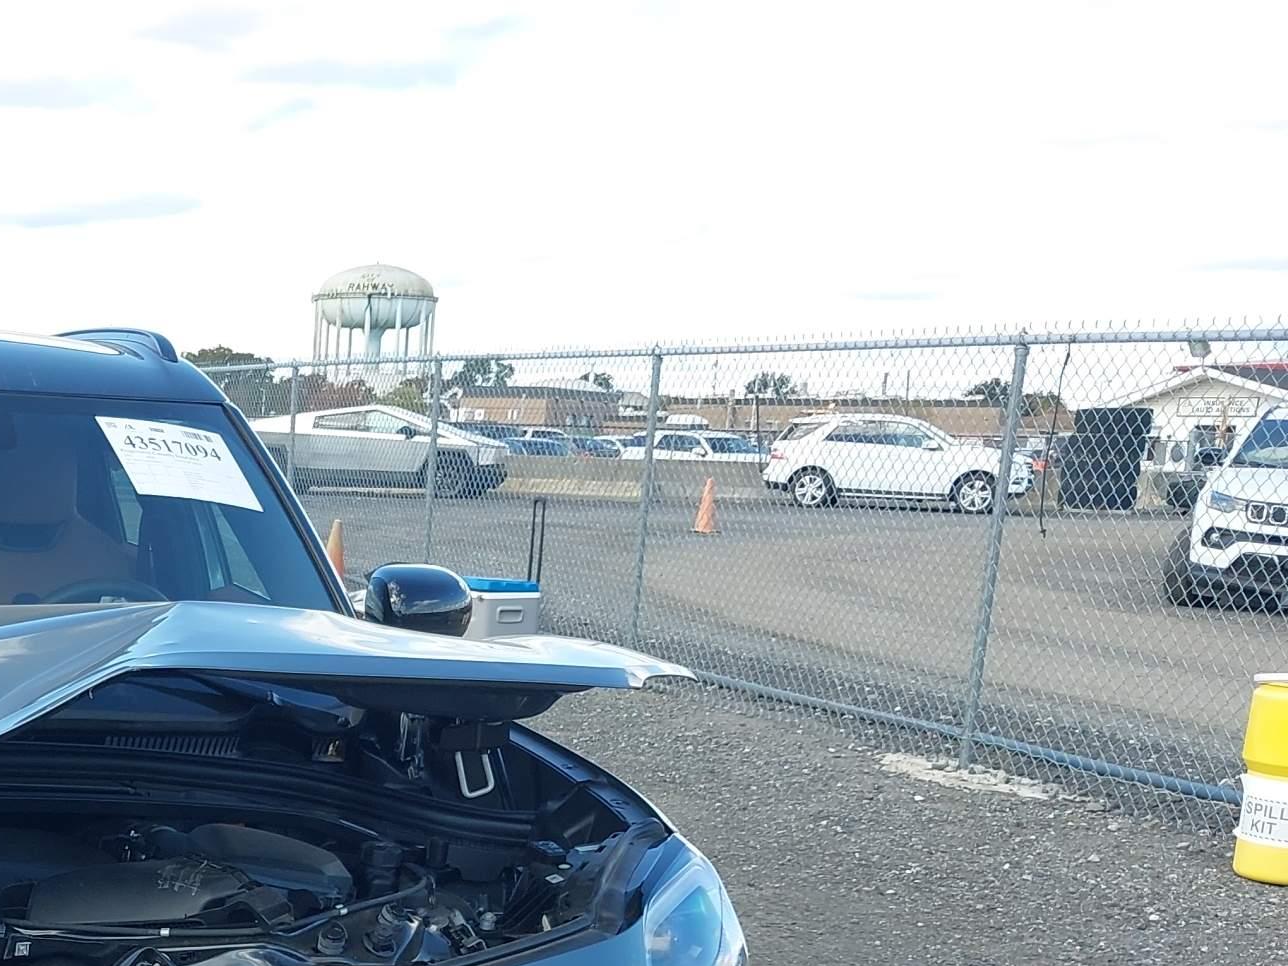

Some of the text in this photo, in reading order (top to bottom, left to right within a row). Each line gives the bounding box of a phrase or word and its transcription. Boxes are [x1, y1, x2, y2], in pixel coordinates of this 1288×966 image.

[347, 282, 394, 291] RAHWAY
[123, 435, 221, 462] 43517094
[1246, 801, 1288, 821] SPILL
[1250, 819, 1277, 835] KIT
